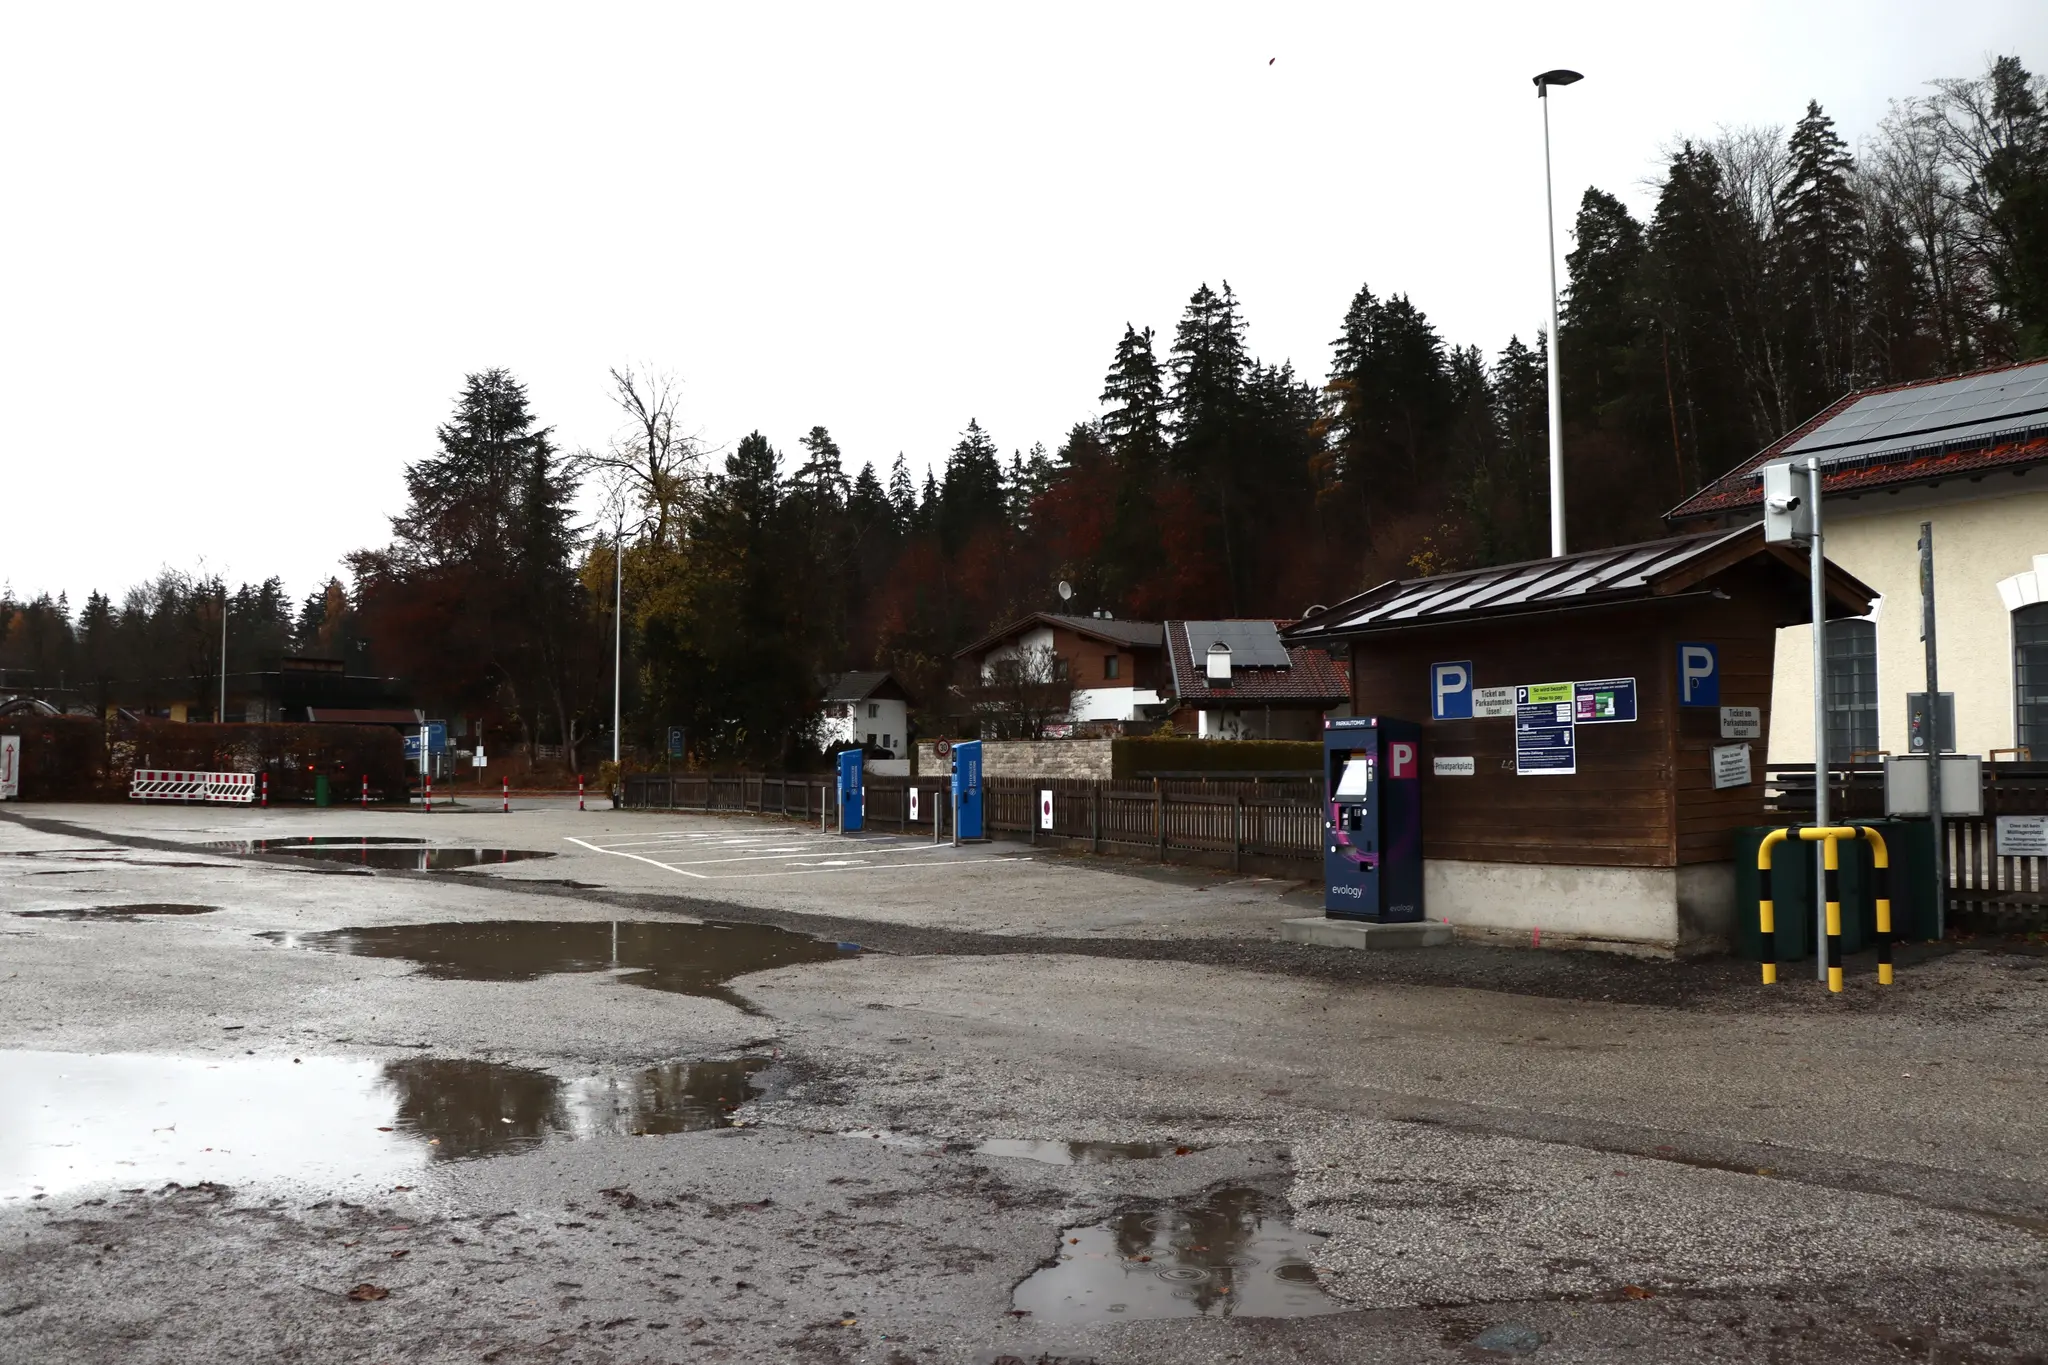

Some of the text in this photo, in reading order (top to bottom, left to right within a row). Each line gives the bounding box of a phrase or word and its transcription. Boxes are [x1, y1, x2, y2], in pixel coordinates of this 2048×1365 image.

[1682, 646, 1713, 702] P
[1436, 666, 1467, 716] P
[1519, 689, 1527, 702] P
[1475, 699, 1512, 707] Parkautomaten
[1486, 707, 1502, 715] lösen!
[1729, 709, 1744, 717] Ticket
[1723, 718, 1758, 726] Parkautomaten
[1734, 728, 1749, 736] lösen!
[940, 744, 948, 752] 30
[1393, 744, 1413, 777] P
[1435, 761, 1473, 771] Privatparkplatz
[1332, 884, 1362, 898] evology
[1389, 904, 1414, 912] evology
